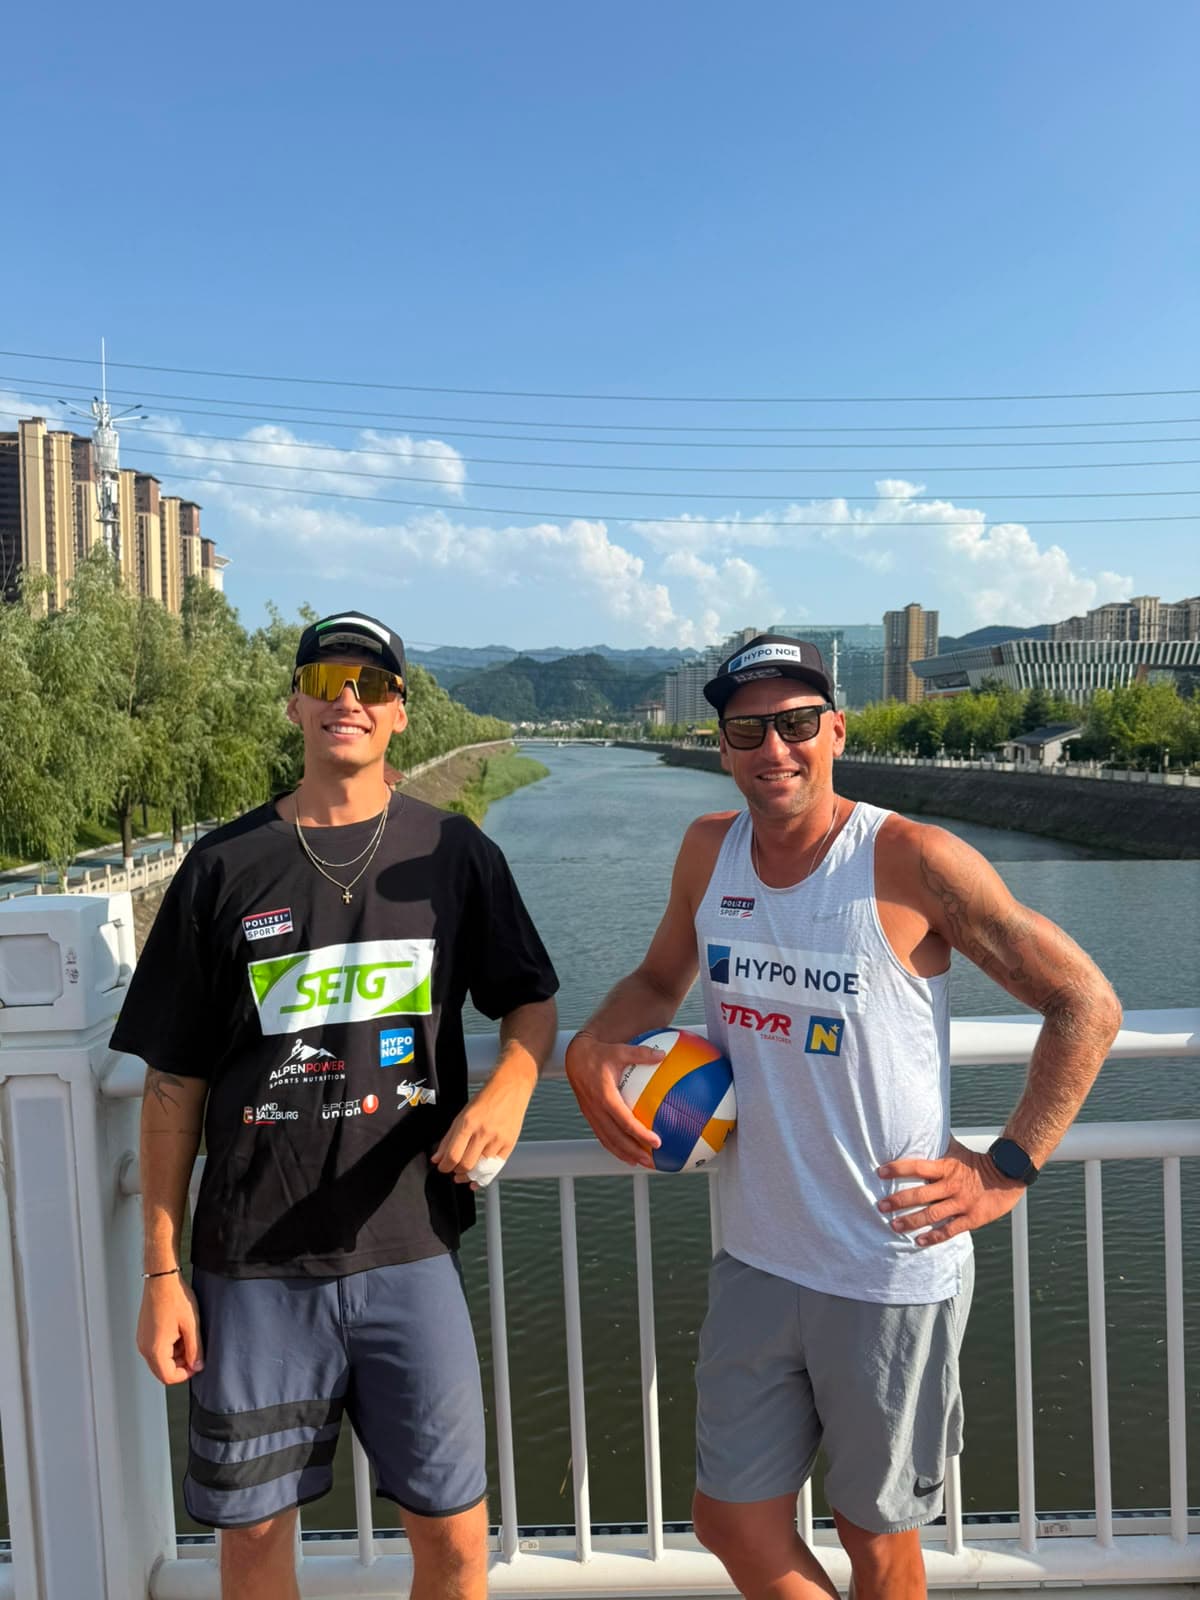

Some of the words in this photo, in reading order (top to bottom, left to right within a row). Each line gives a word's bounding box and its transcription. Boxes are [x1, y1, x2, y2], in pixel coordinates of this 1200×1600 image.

[743, 648, 772, 662] HYPO
[775, 648, 798, 657] NOE
[245, 914, 284, 929] POLIZEI
[247, 927, 276, 939] SPORT
[735, 957, 796, 986] HYPO
[804, 967, 859, 995] NOE
[279, 960, 413, 1014] SETG
[381, 1036, 412, 1048] HYPO
[381, 1046, 404, 1058] NOE
[269, 1061, 345, 1081] ALPENPOWER
[269, 1077, 299, 1089] SPORTS
[303, 1073, 345, 1083] NUTRITION
[256, 1102, 278, 1115] LAND
[322, 1099, 361, 1111] SPORT
[255, 1110, 299, 1121] SALZBURG
